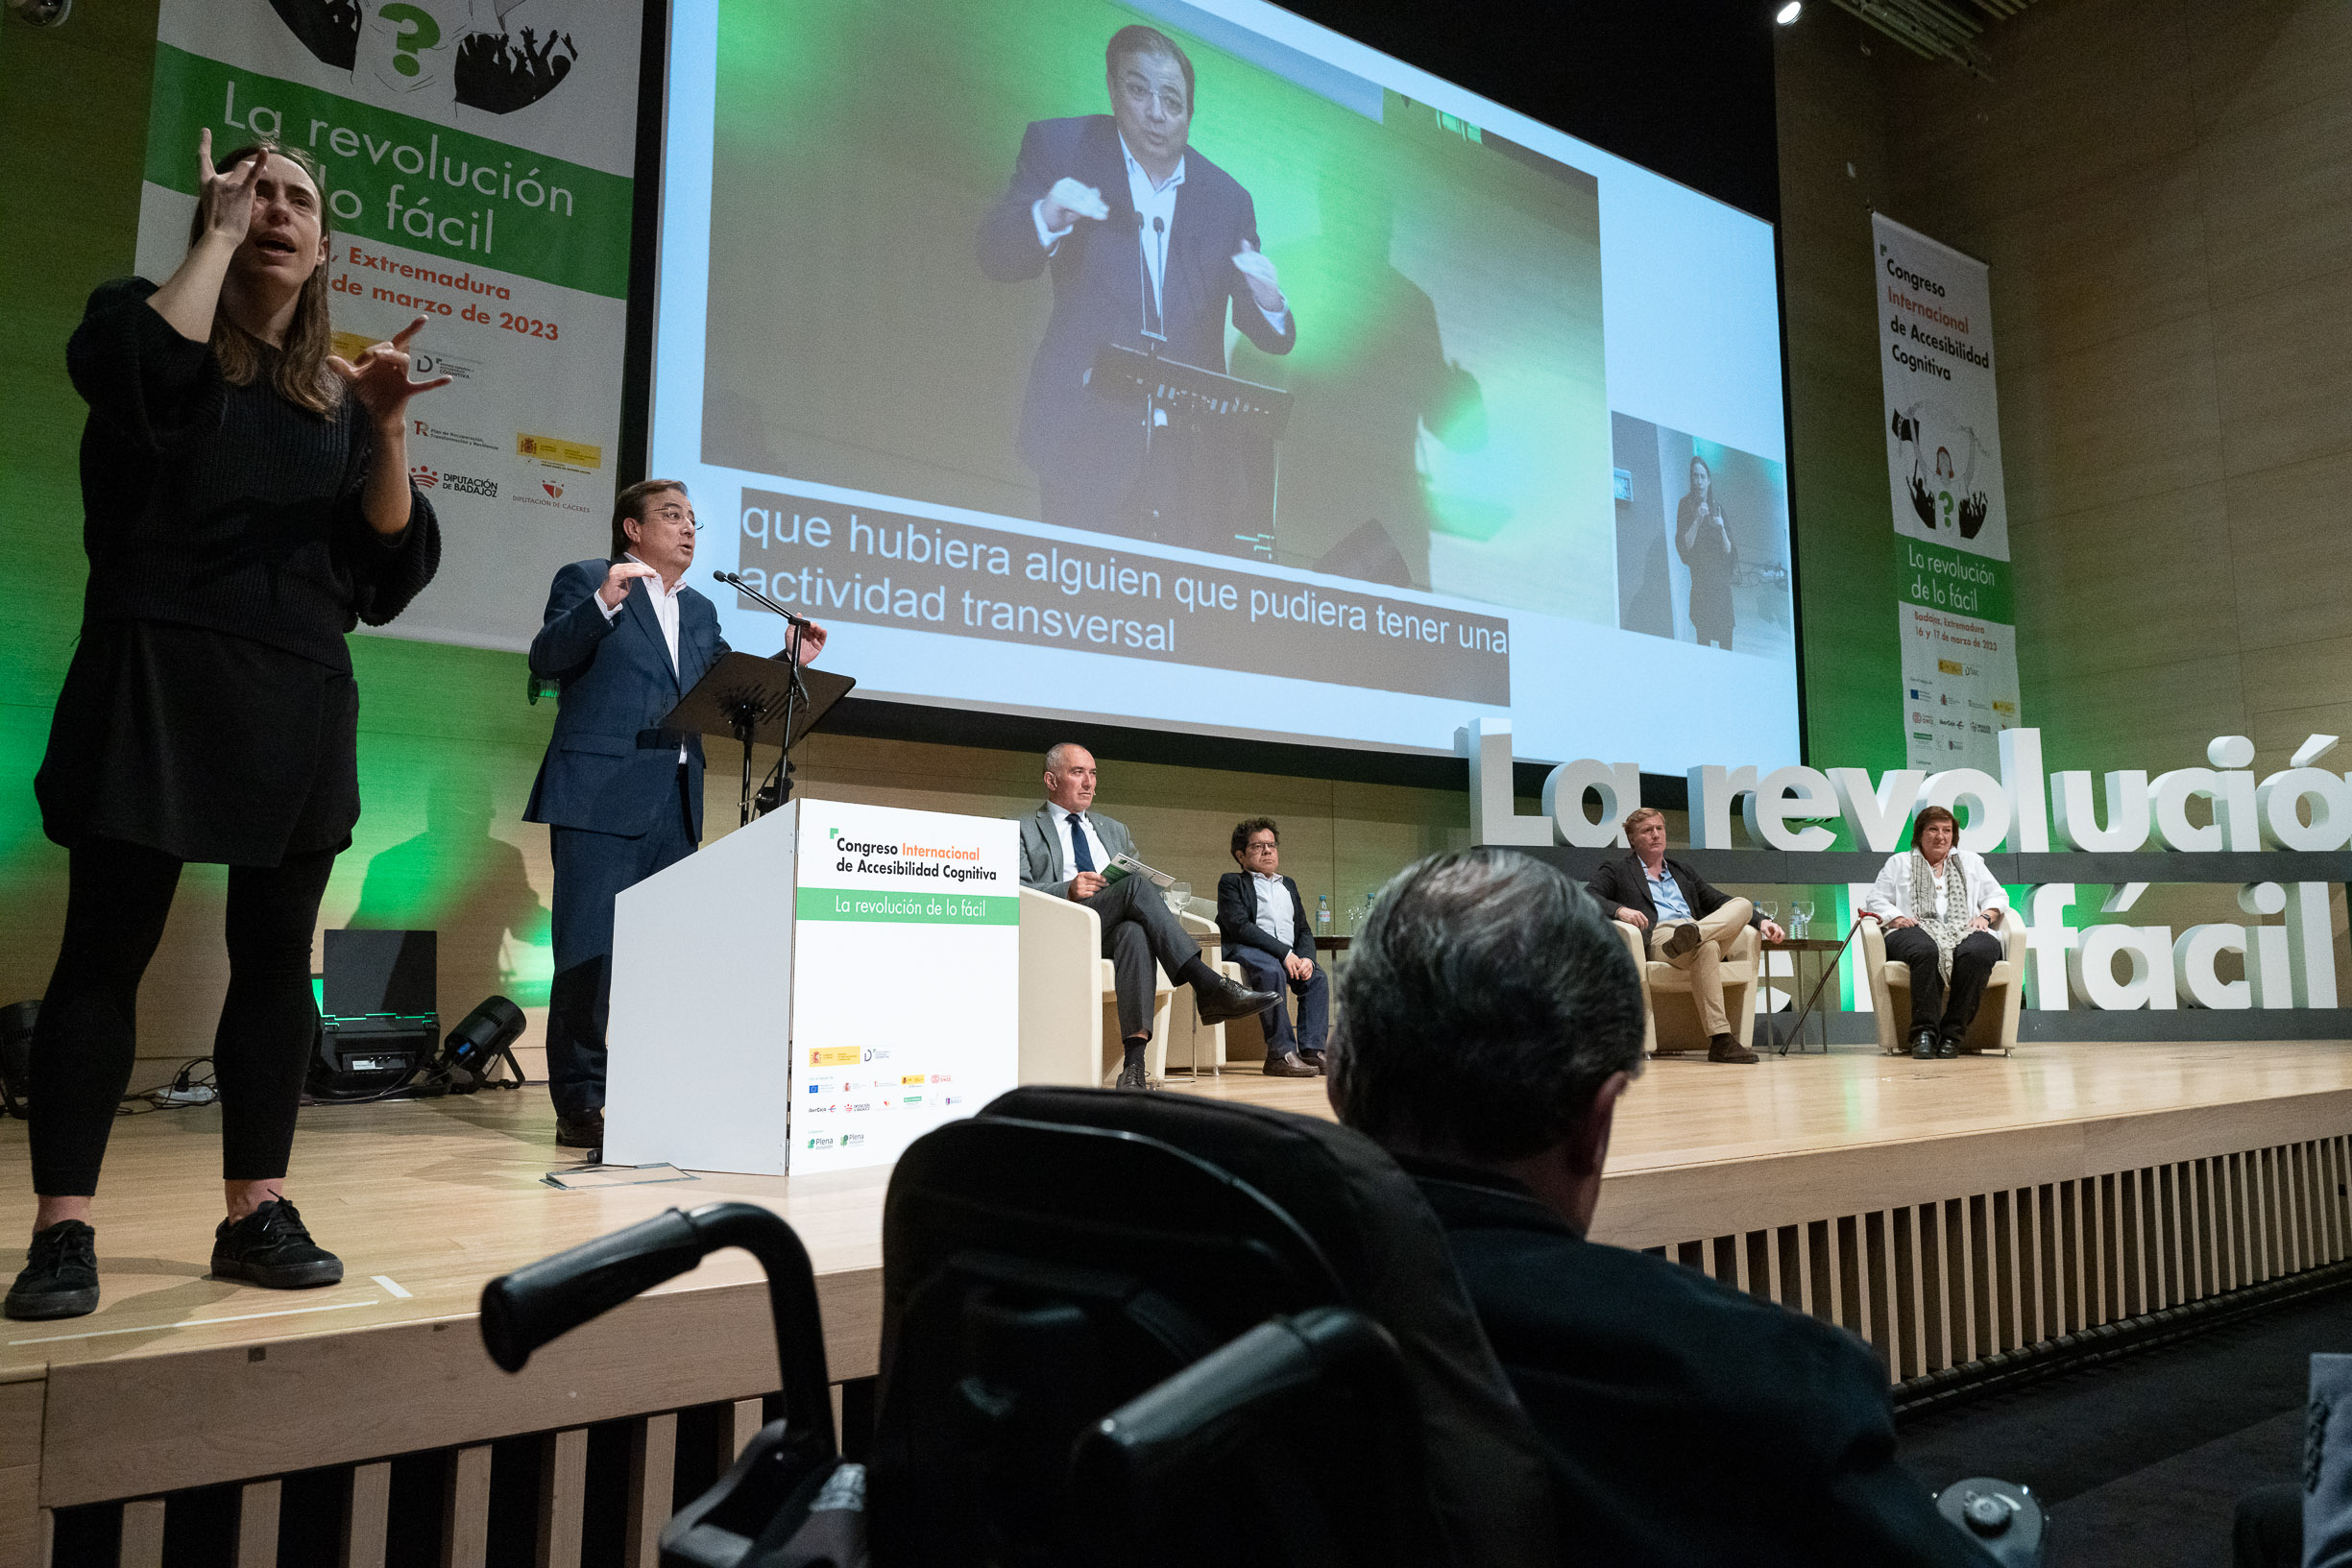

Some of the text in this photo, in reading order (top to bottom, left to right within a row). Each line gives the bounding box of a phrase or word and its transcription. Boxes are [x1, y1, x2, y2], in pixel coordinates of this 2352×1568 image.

[224, 81, 573, 217] La revolución
[386, 183, 494, 253] fácil
[349, 246, 511, 301] Extremadura
[1886, 258, 1946, 298] Congreso
[330, 274, 559, 341] de marzo de 2023
[1888, 286, 1970, 335] Internacional
[1890, 315, 1990, 369] de Accesibilidad
[439, 369, 470, 380] COGNITIVA
[1892, 344, 1952, 382] Cognitiva
[442, 482, 498, 499] DE BADAJOZ
[443, 472, 498, 491] DIPUTACIÓN
[512, 495, 551, 507] DIPUTACIÓN
[742, 507, 1508, 654] que hubiera alguien que pudiera tener una
[1908, 543, 1996, 587] La revolución
[740, 566, 1175, 652] actividad transversal
[1911, 574, 1978, 612] de lo fácil
[1915, 626, 1998, 652] 16 y 17 de marzo de 2023
[1944, 617, 1985, 635] Extremadura
[1468, 717, 2352, 853] La revolució
[837, 837, 981, 860] Congreso Internacional
[836, 856, 997, 882] de Accesibilidad Cognitiva
[836, 895, 986, 917] La revolución de lo fácil
[2021, 881, 2339, 1011] fácil
